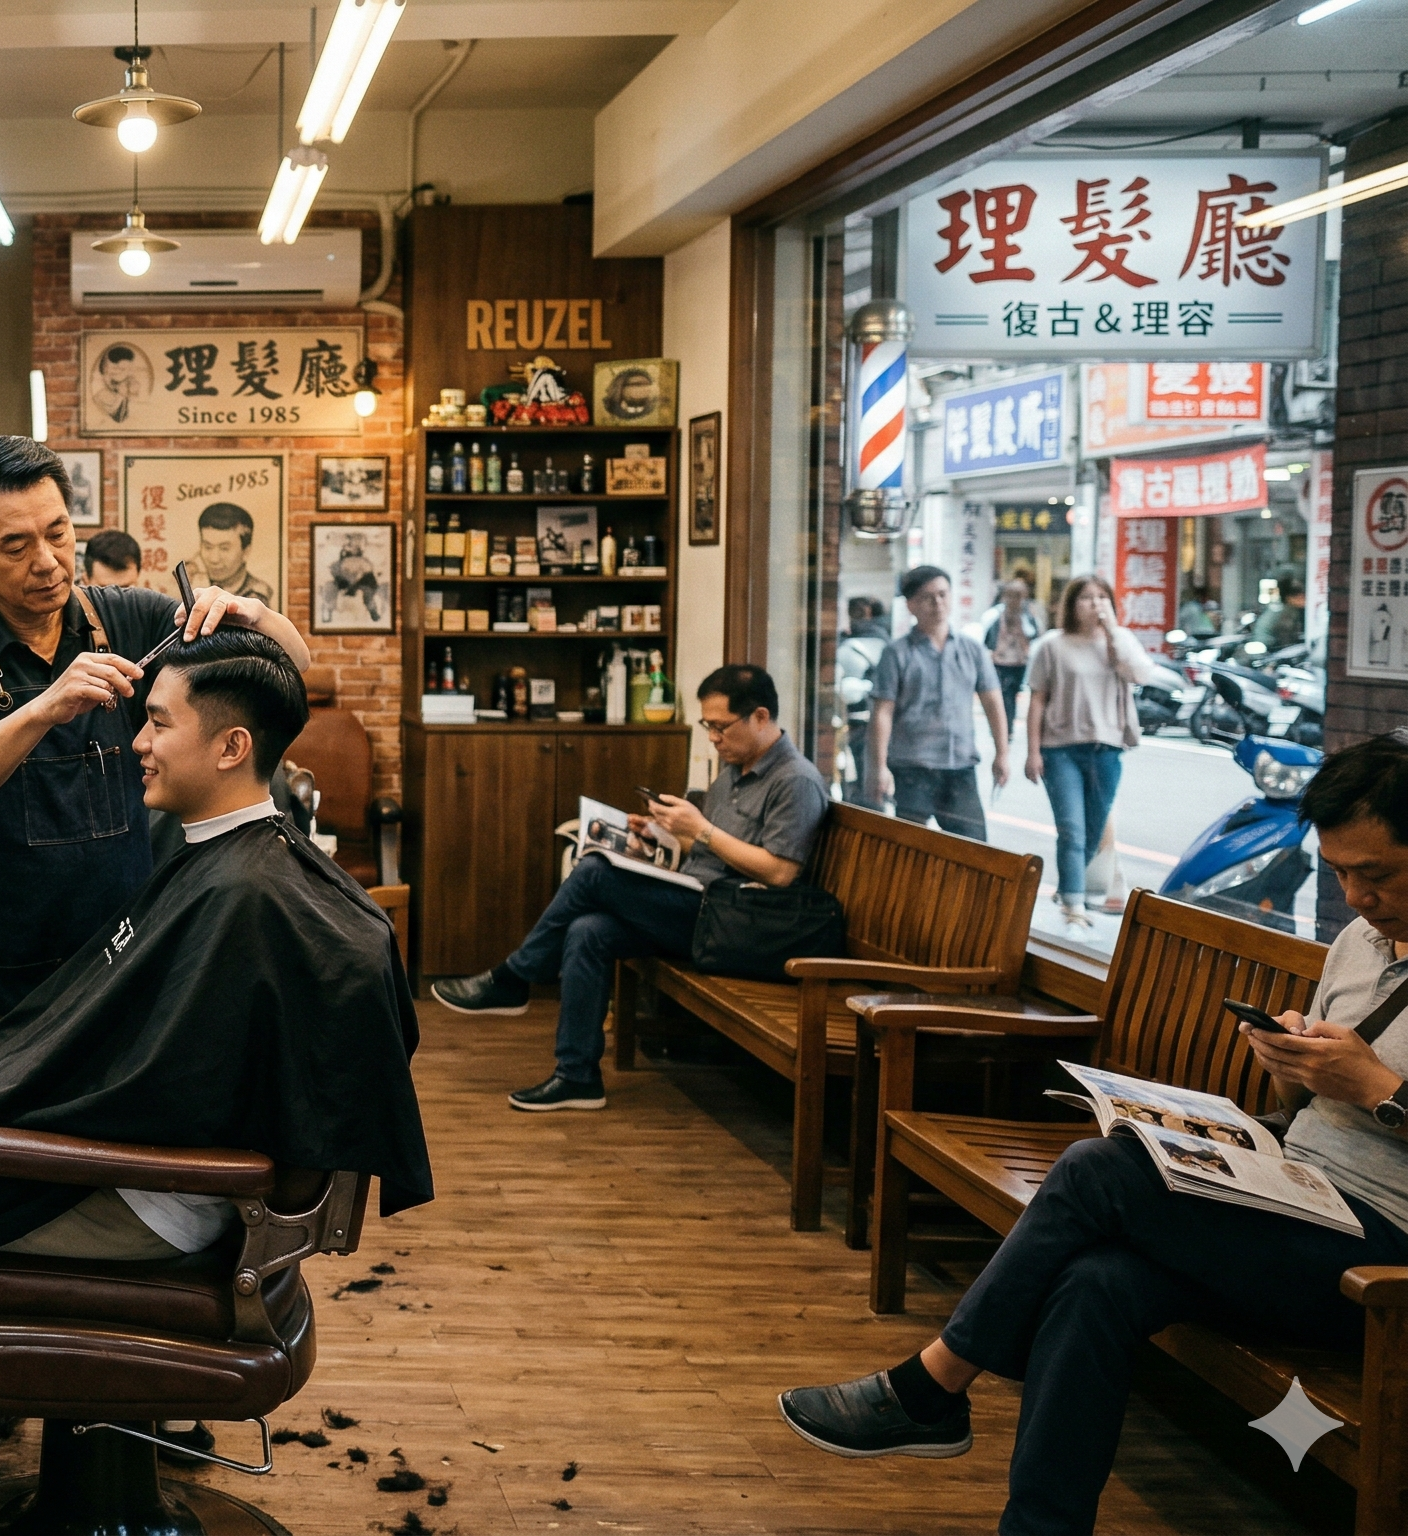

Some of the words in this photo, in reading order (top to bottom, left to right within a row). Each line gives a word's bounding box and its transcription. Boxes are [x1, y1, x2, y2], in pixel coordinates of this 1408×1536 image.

[934, 174, 1291, 289] 理髮廳
[466, 299, 612, 350] REUZEL
[164, 338, 352, 401] 理髮廳
[177, 406, 238, 424] Since
[248, 405, 301, 423] 1985
[176, 482, 222, 501] Since
[228, 469, 269, 492] 1985
